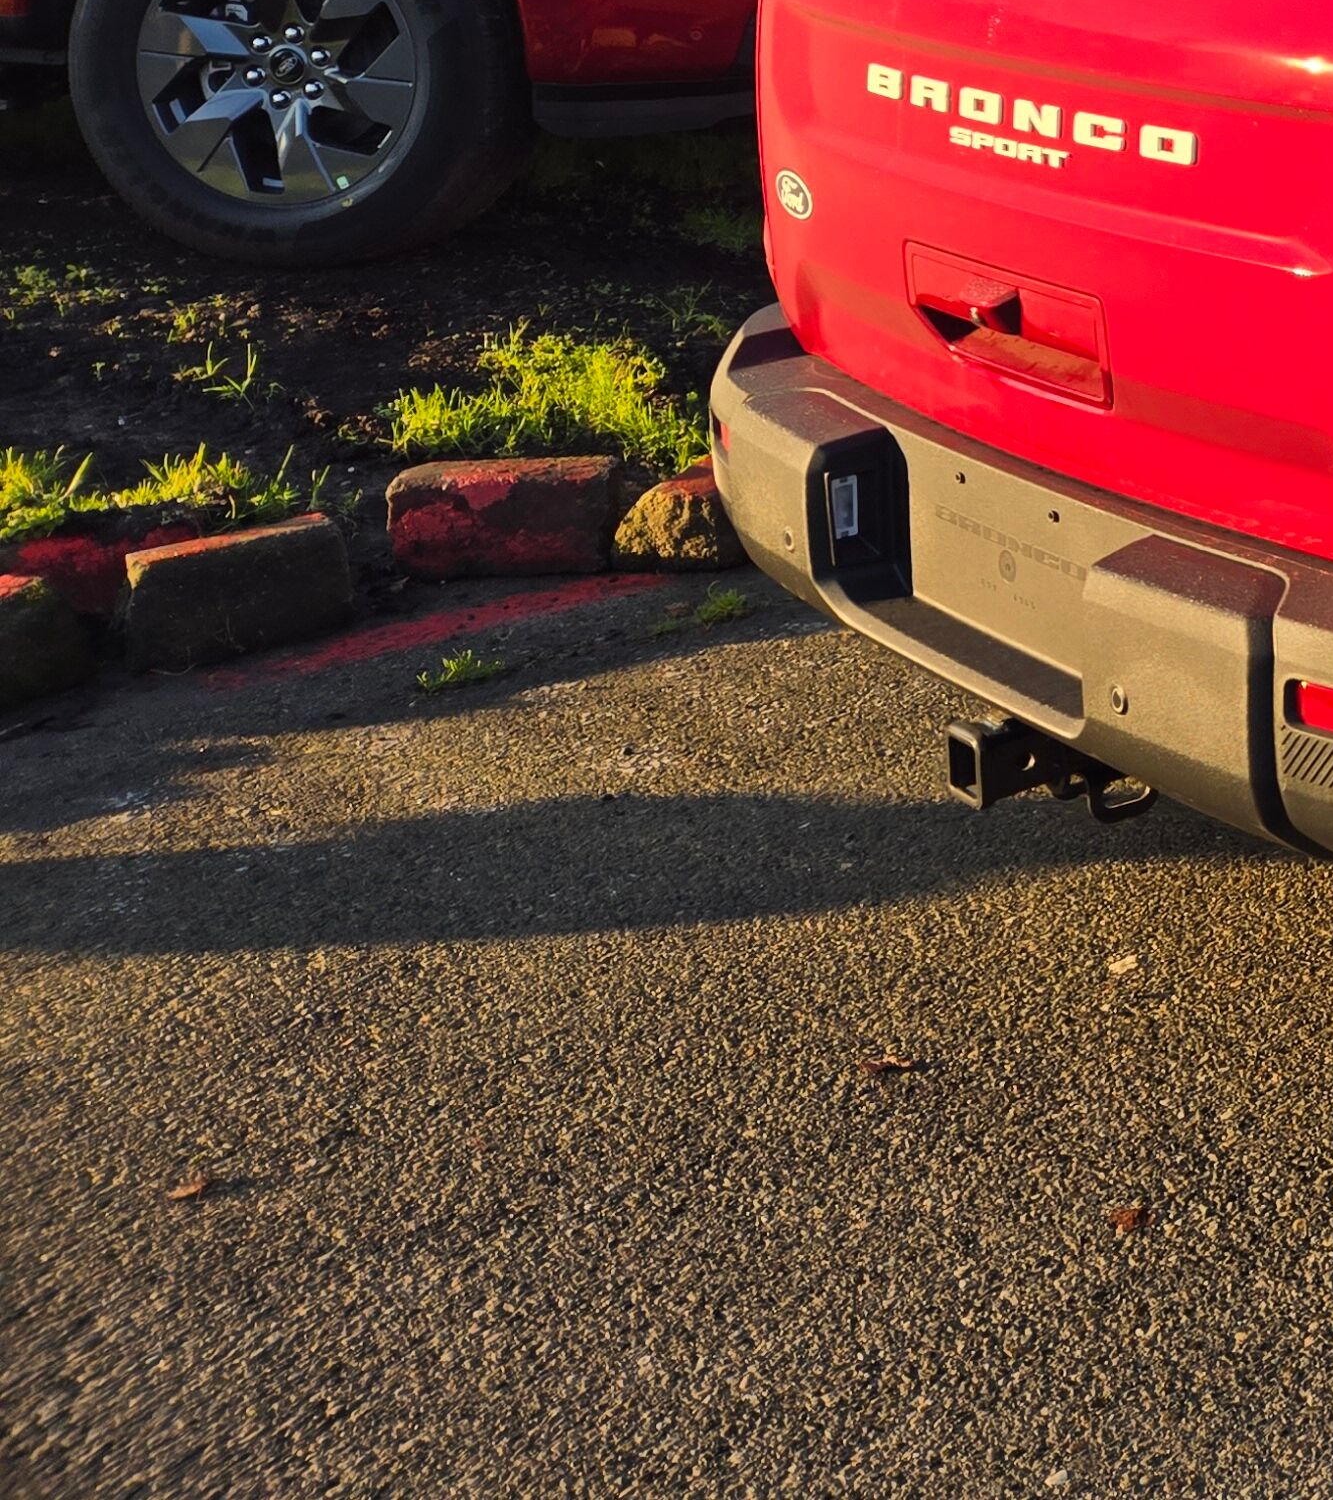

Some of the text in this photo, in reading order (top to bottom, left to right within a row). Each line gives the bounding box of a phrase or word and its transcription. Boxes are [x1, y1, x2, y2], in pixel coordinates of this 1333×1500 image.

[867, 62, 1198, 166] BRONCO
[949, 125, 1071, 169] SPORT
[935, 503, 1088, 581] BRONCO
